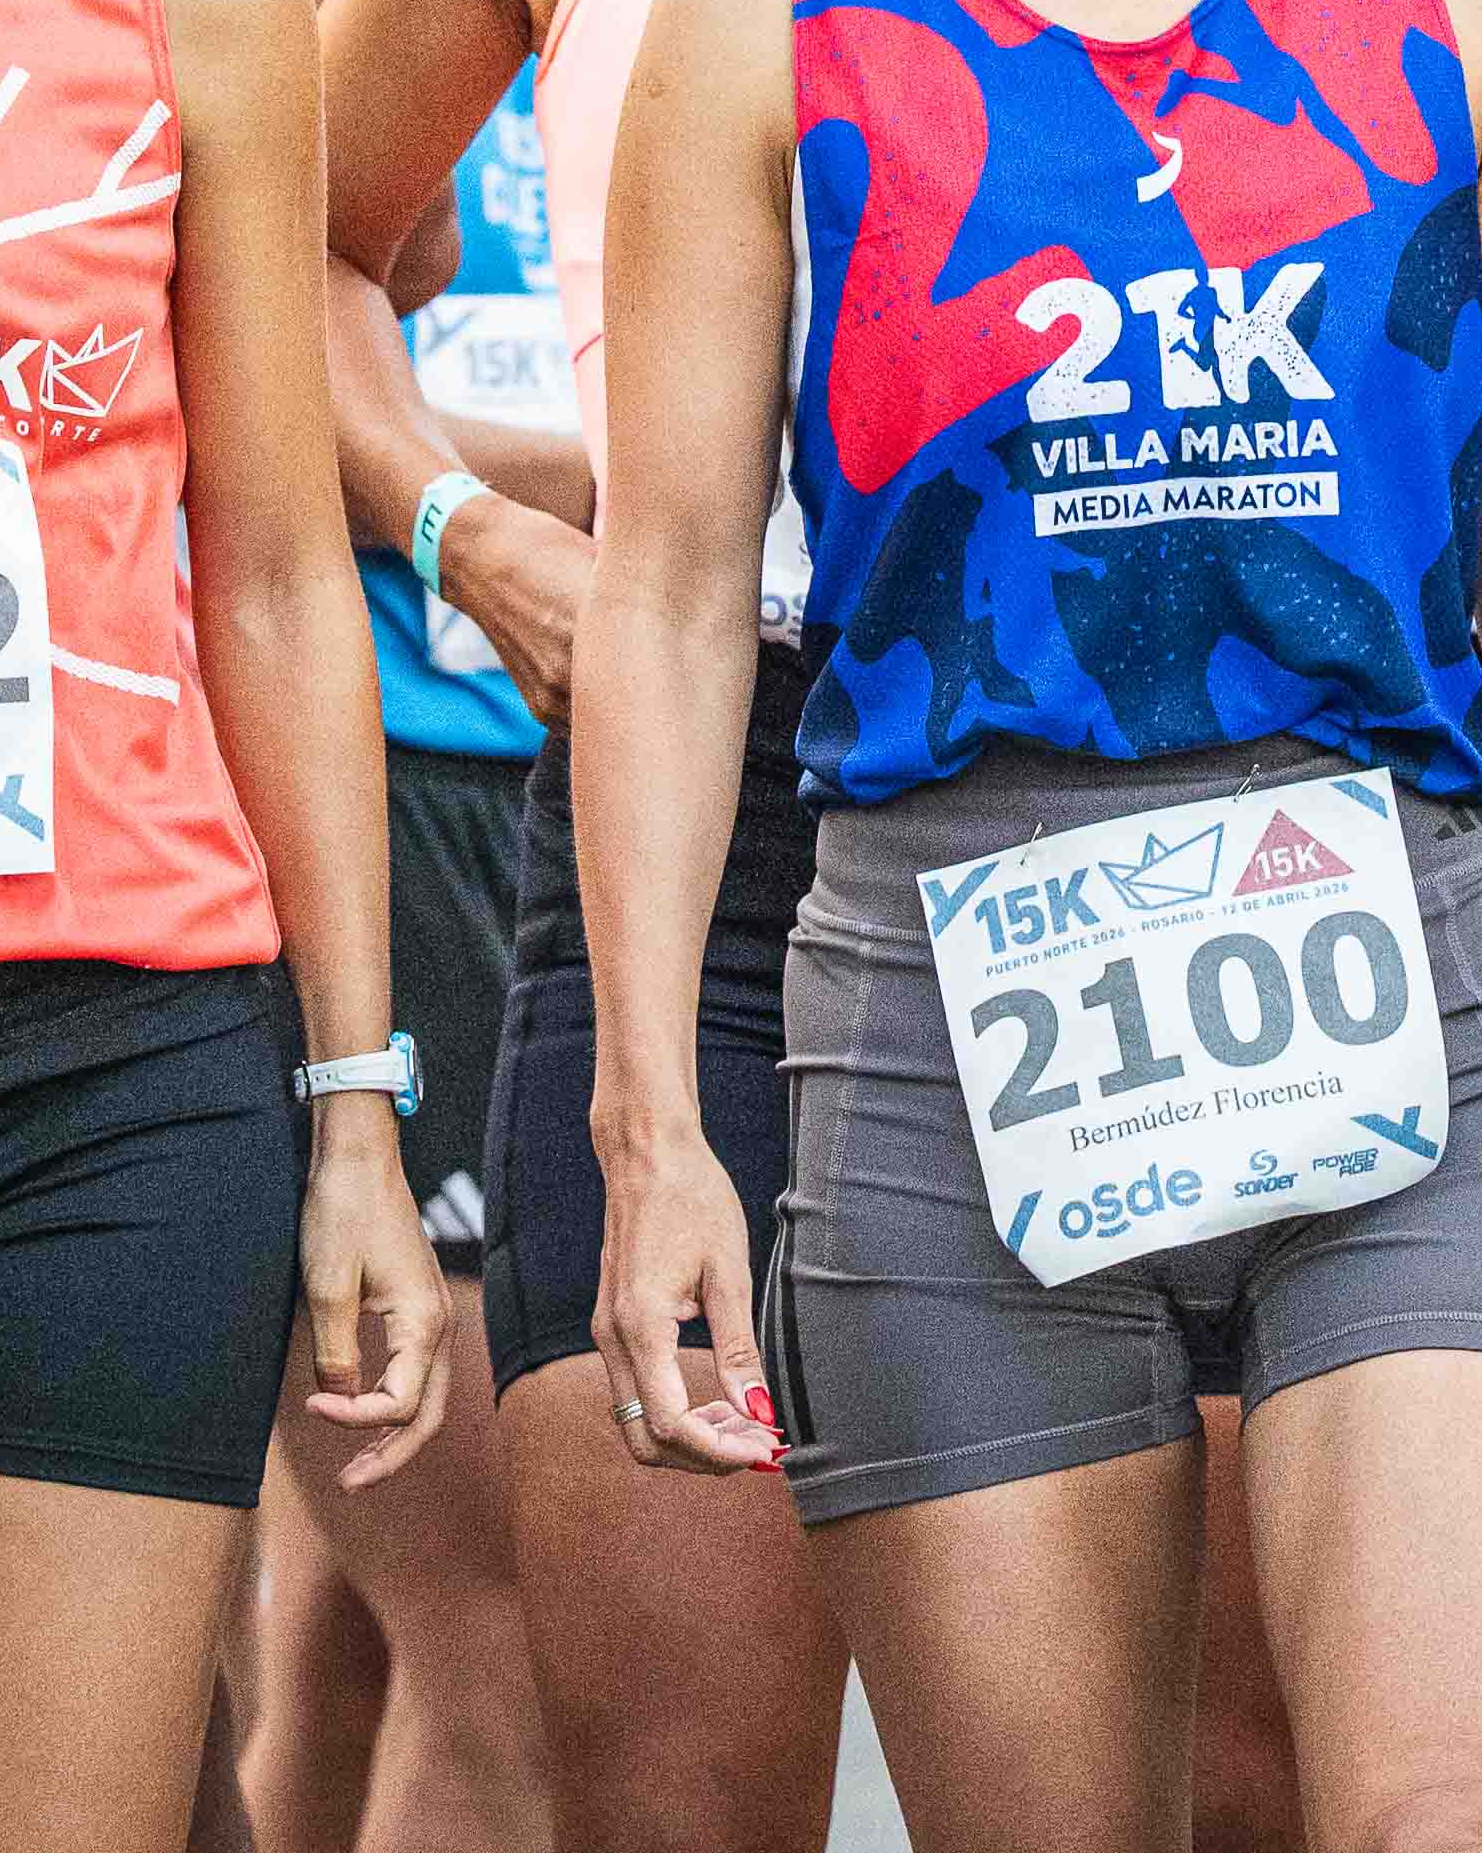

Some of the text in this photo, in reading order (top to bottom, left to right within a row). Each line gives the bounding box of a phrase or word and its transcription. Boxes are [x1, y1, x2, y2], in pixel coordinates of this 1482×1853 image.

[462, 341, 539, 386] 15K
[1015, 262, 1336, 423] 21K
[1032, 419, 1338, 479] VILLA MARIA
[1053, 481, 1324, 527] MEDIA MARATON
[1253, 841, 1321, 884] 15K
[973, 867, 1102, 956] 15K
[985, 883, 1350, 977] PUERTO NORTE 2026 ROSARIO 12 DE ABRIL 2026
[969, 910, 1409, 1132] 2100
[1069, 1071, 1344, 1153] Bermúdez Florencia
[1313, 1147, 1378, 1172] POWER
[1058, 1164, 1203, 1241] osde
